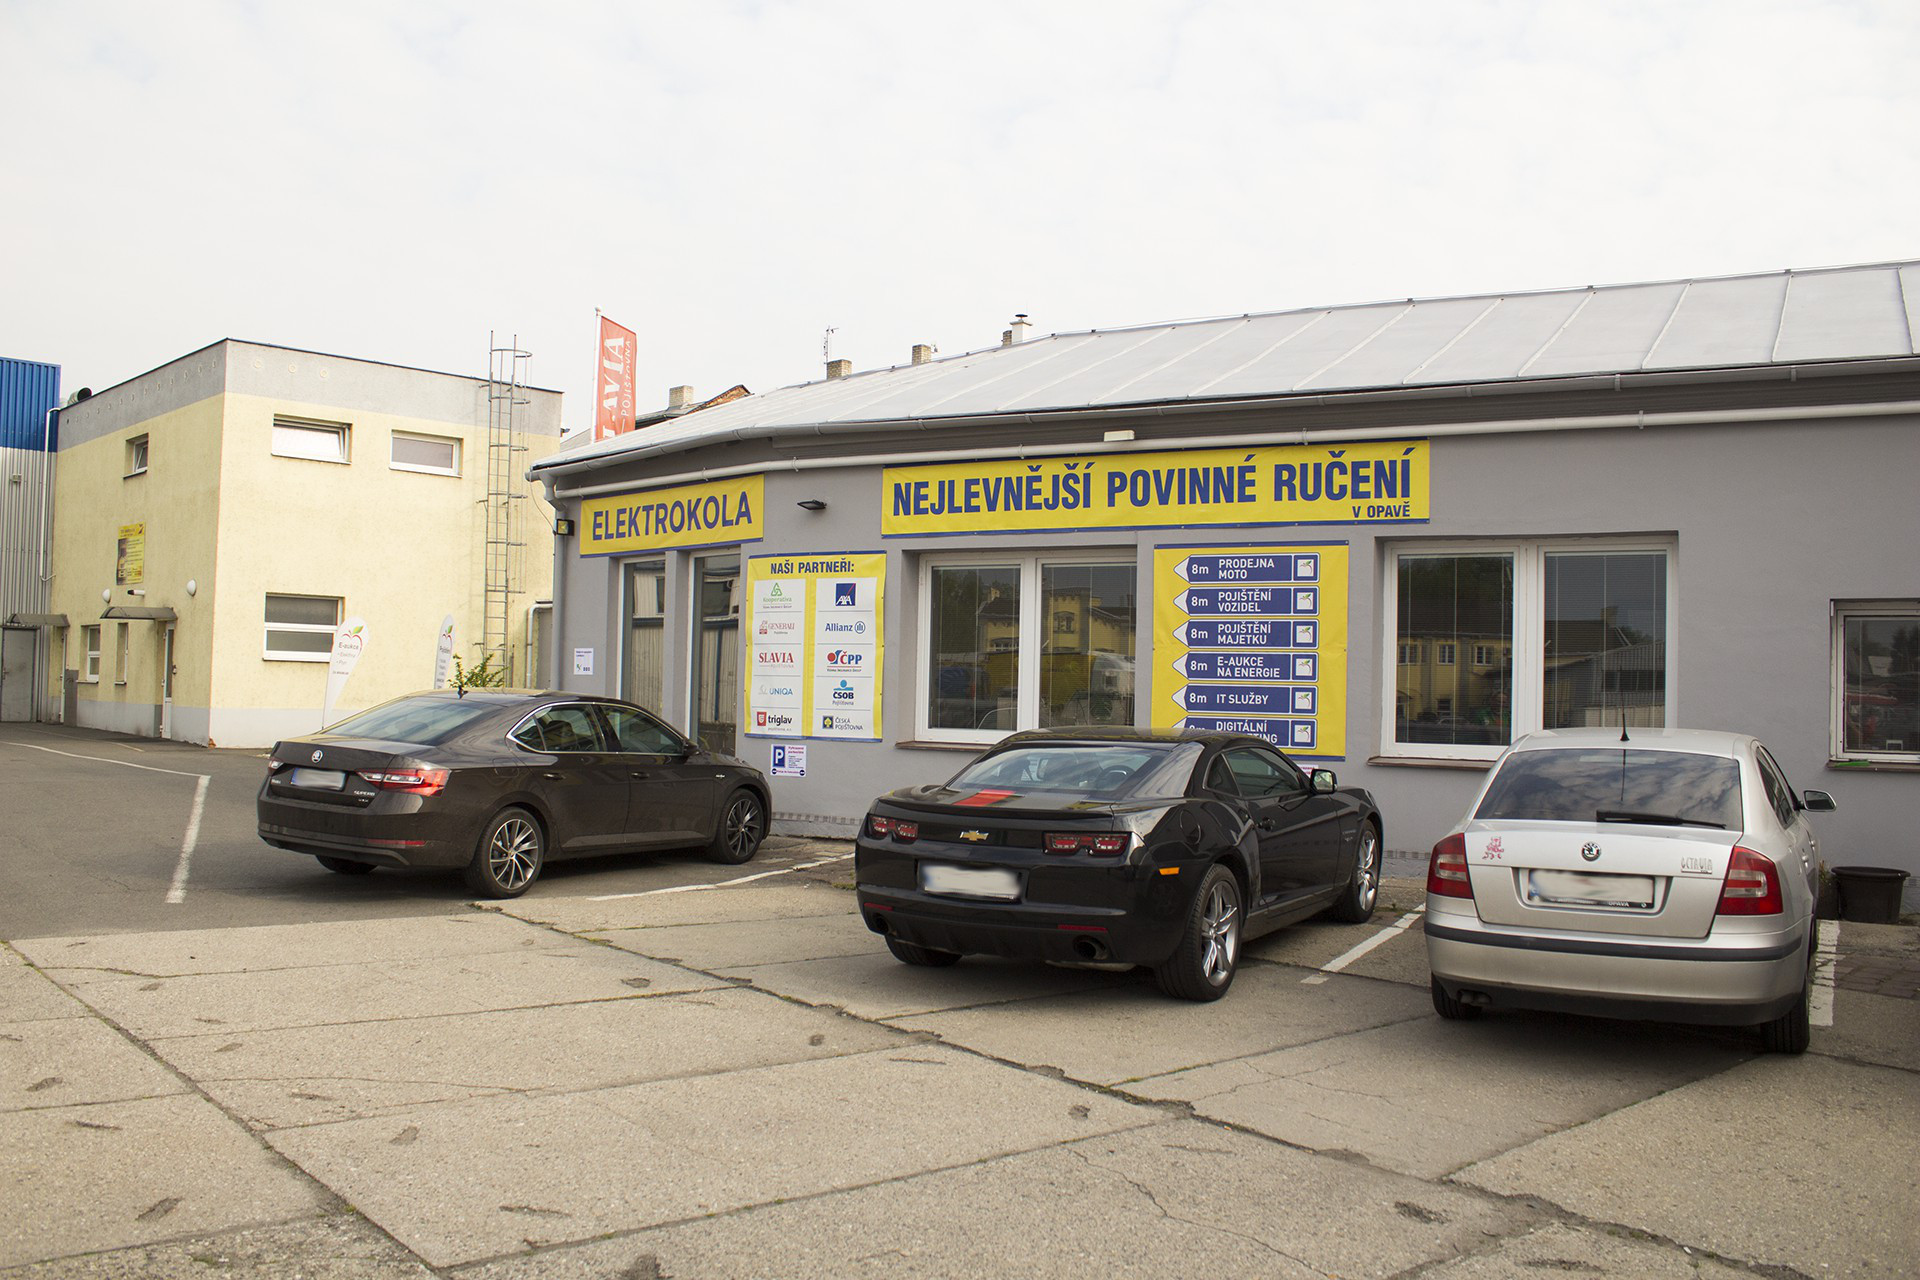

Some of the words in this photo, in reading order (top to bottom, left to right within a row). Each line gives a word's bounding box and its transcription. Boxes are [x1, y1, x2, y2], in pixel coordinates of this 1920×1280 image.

[893, 462, 1095, 516] NEJLEVNĚJŠÍ
[1107, 454, 1256, 507] POVINNÉ
[1274, 449, 1415, 502] RUČENÍ
[1352, 505, 1361, 519] V
[1367, 501, 1410, 518] OPAVĚ
[592, 491, 753, 541] ELEKTROKOLA
[770, 559, 794, 575] NAŠI
[798, 557, 855, 574] PARTNEŘI:
[1218, 558, 1275, 568] PRODEJNA
[1191, 564, 1209, 574] 8m
[1218, 570, 1248, 579] MOTO
[835, 595, 853, 605] AXA
[1218, 588, 1272, 601] POJIŠTĚNÍ
[1191, 596, 1208, 606] 8m
[1218, 602, 1261, 612] VOZIDEL
[825, 623, 853, 632] Allianz
[1217, 621, 1271, 634] POJIŠTĚNÍ
[1190, 628, 1208, 639] 8m
[1217, 635, 1267, 645] MAJETKU
[758, 652, 794, 663] SLAVIA
[840, 651, 862, 665] ČPP
[1217, 656, 1264, 667] E-AUKCE
[1190, 660, 1208, 671] 8m
[1217, 667, 1232, 677] NA
[1234, 668, 1281, 678] ENERGIE
[769, 687, 793, 695] UNIQA
[832, 690, 855, 699] ČSOB
[1189, 693, 1207, 703] 8m
[1216, 694, 1226, 704] IT
[1228, 692, 1269, 705] SLUŽBY
[767, 714, 793, 726] triglav
[1216, 720, 1268, 733] DIGITÁLNÍ
[775, 749, 784, 764] P
